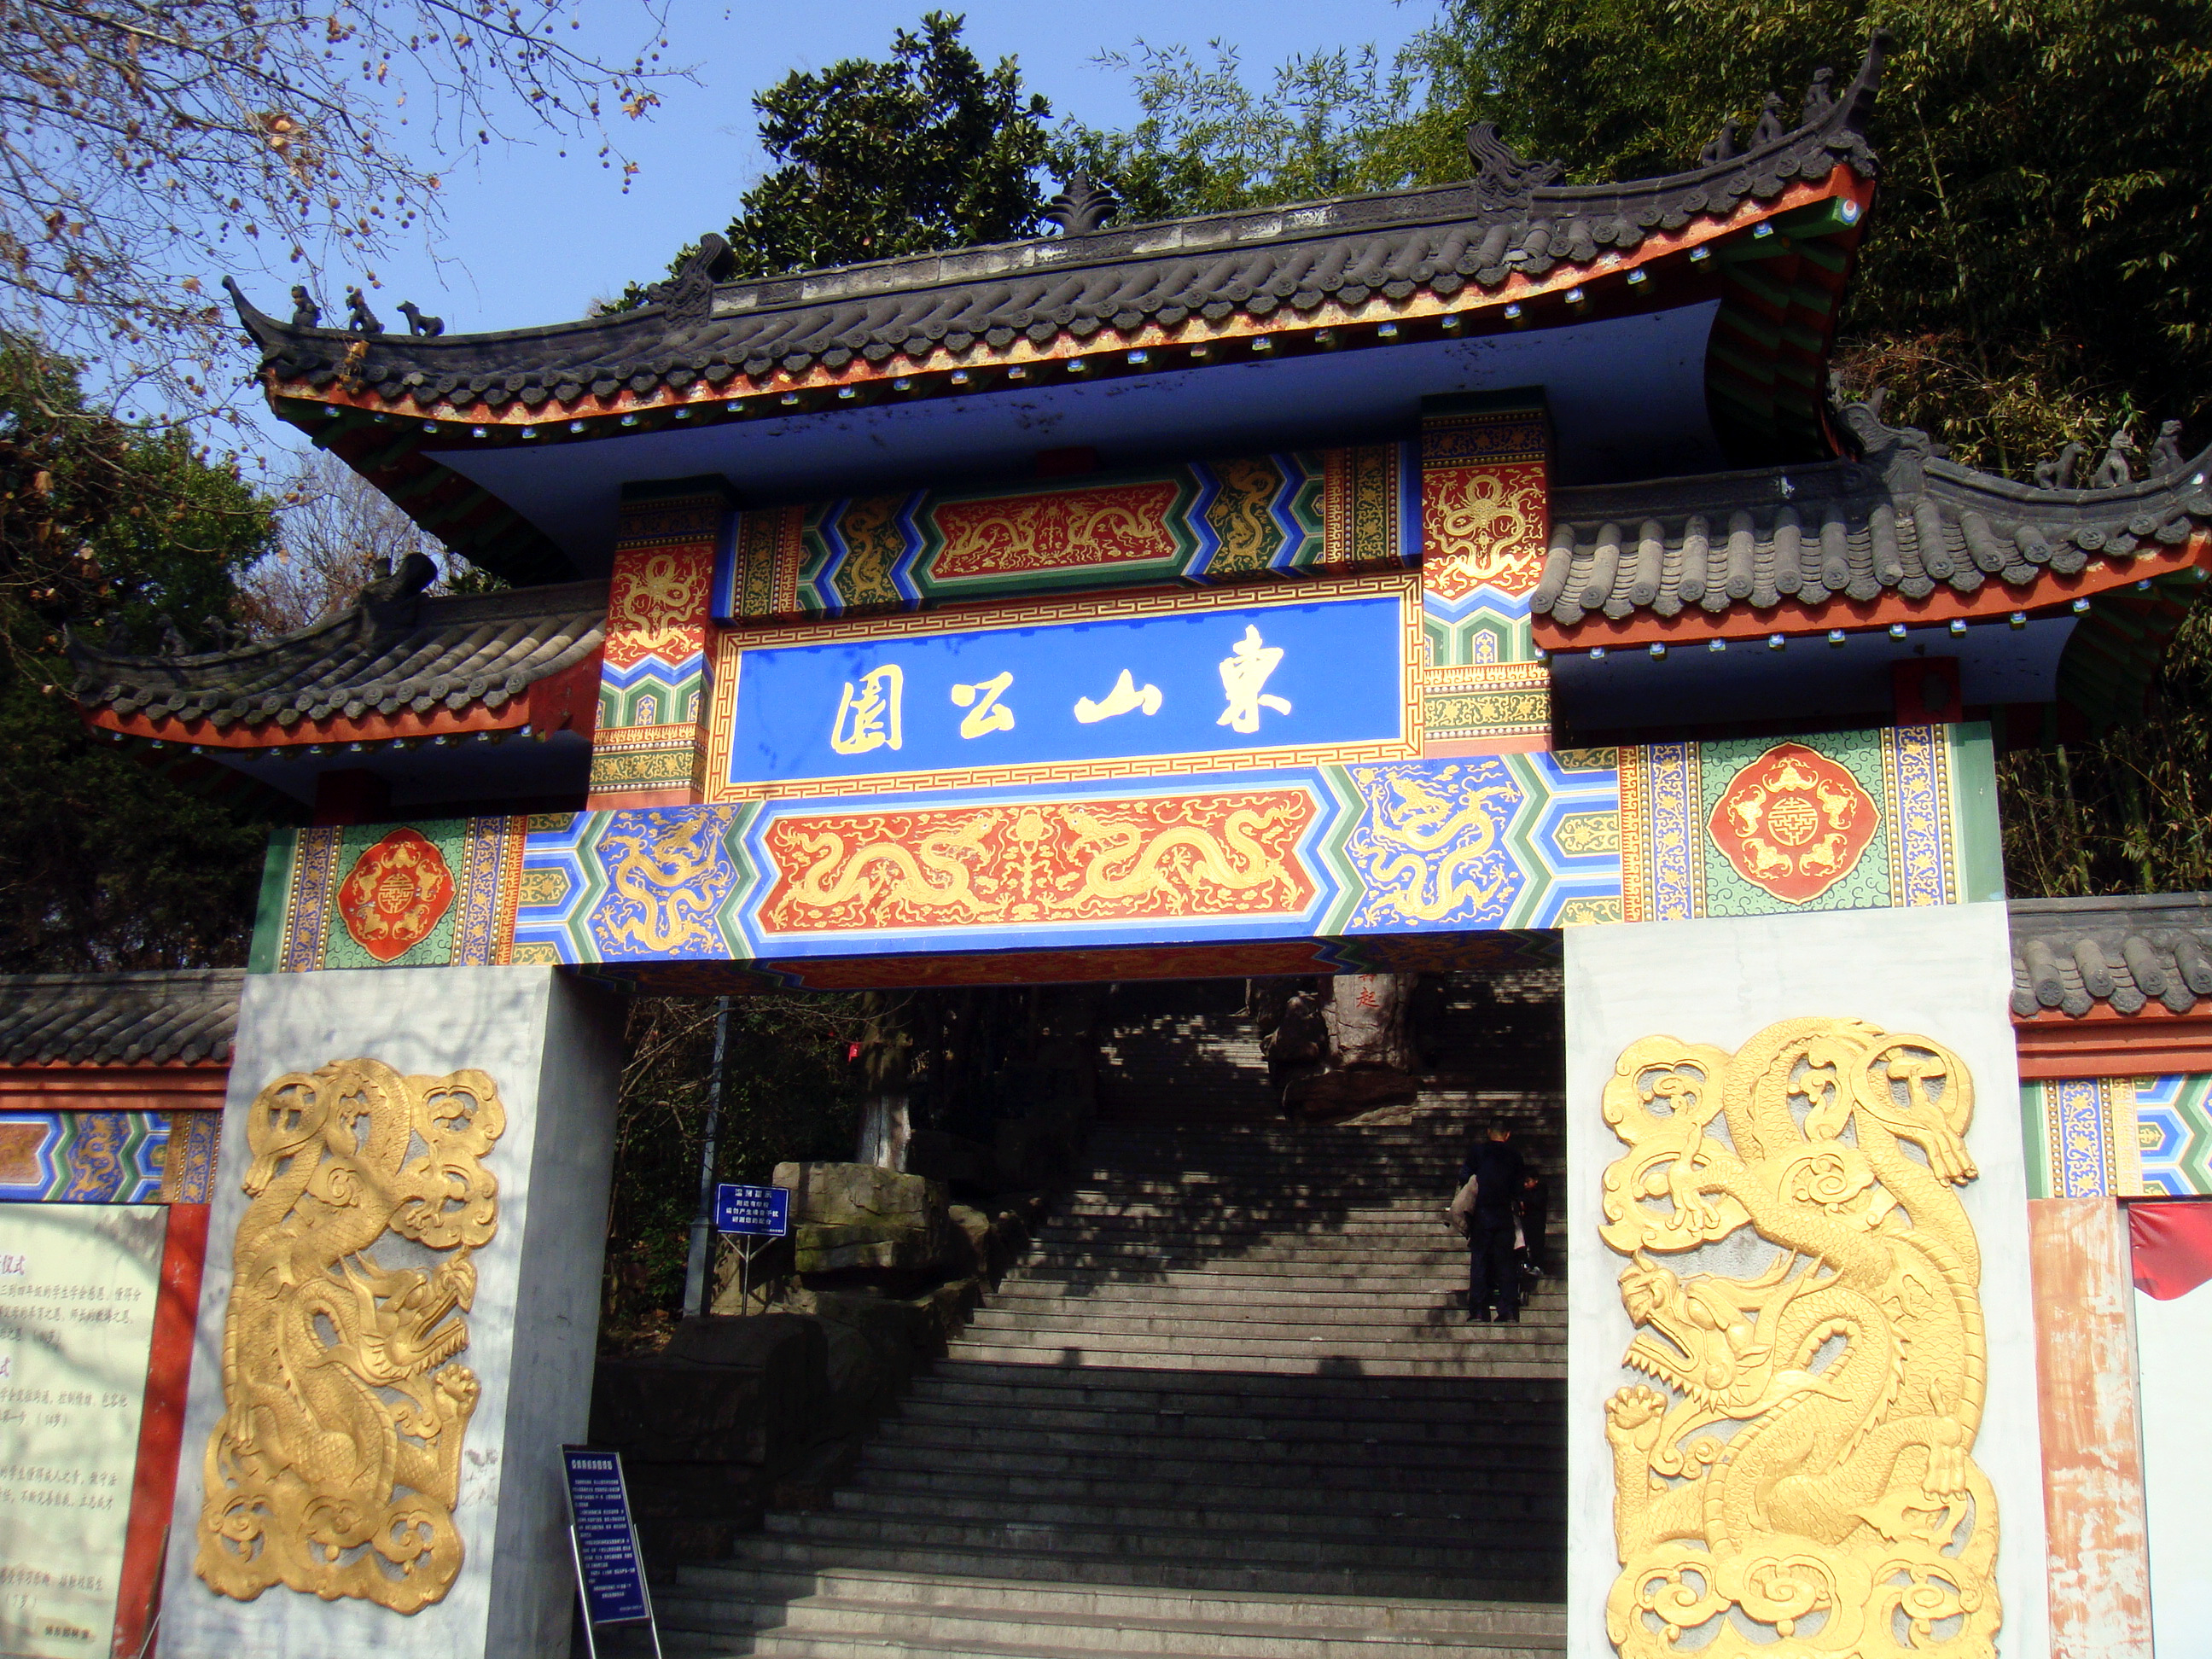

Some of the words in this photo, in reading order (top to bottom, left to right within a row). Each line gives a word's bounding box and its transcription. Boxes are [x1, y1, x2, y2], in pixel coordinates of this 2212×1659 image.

[735, 1188, 771, 1198] 温馨提示
[0, 1254, 26, 1275] 仪式
